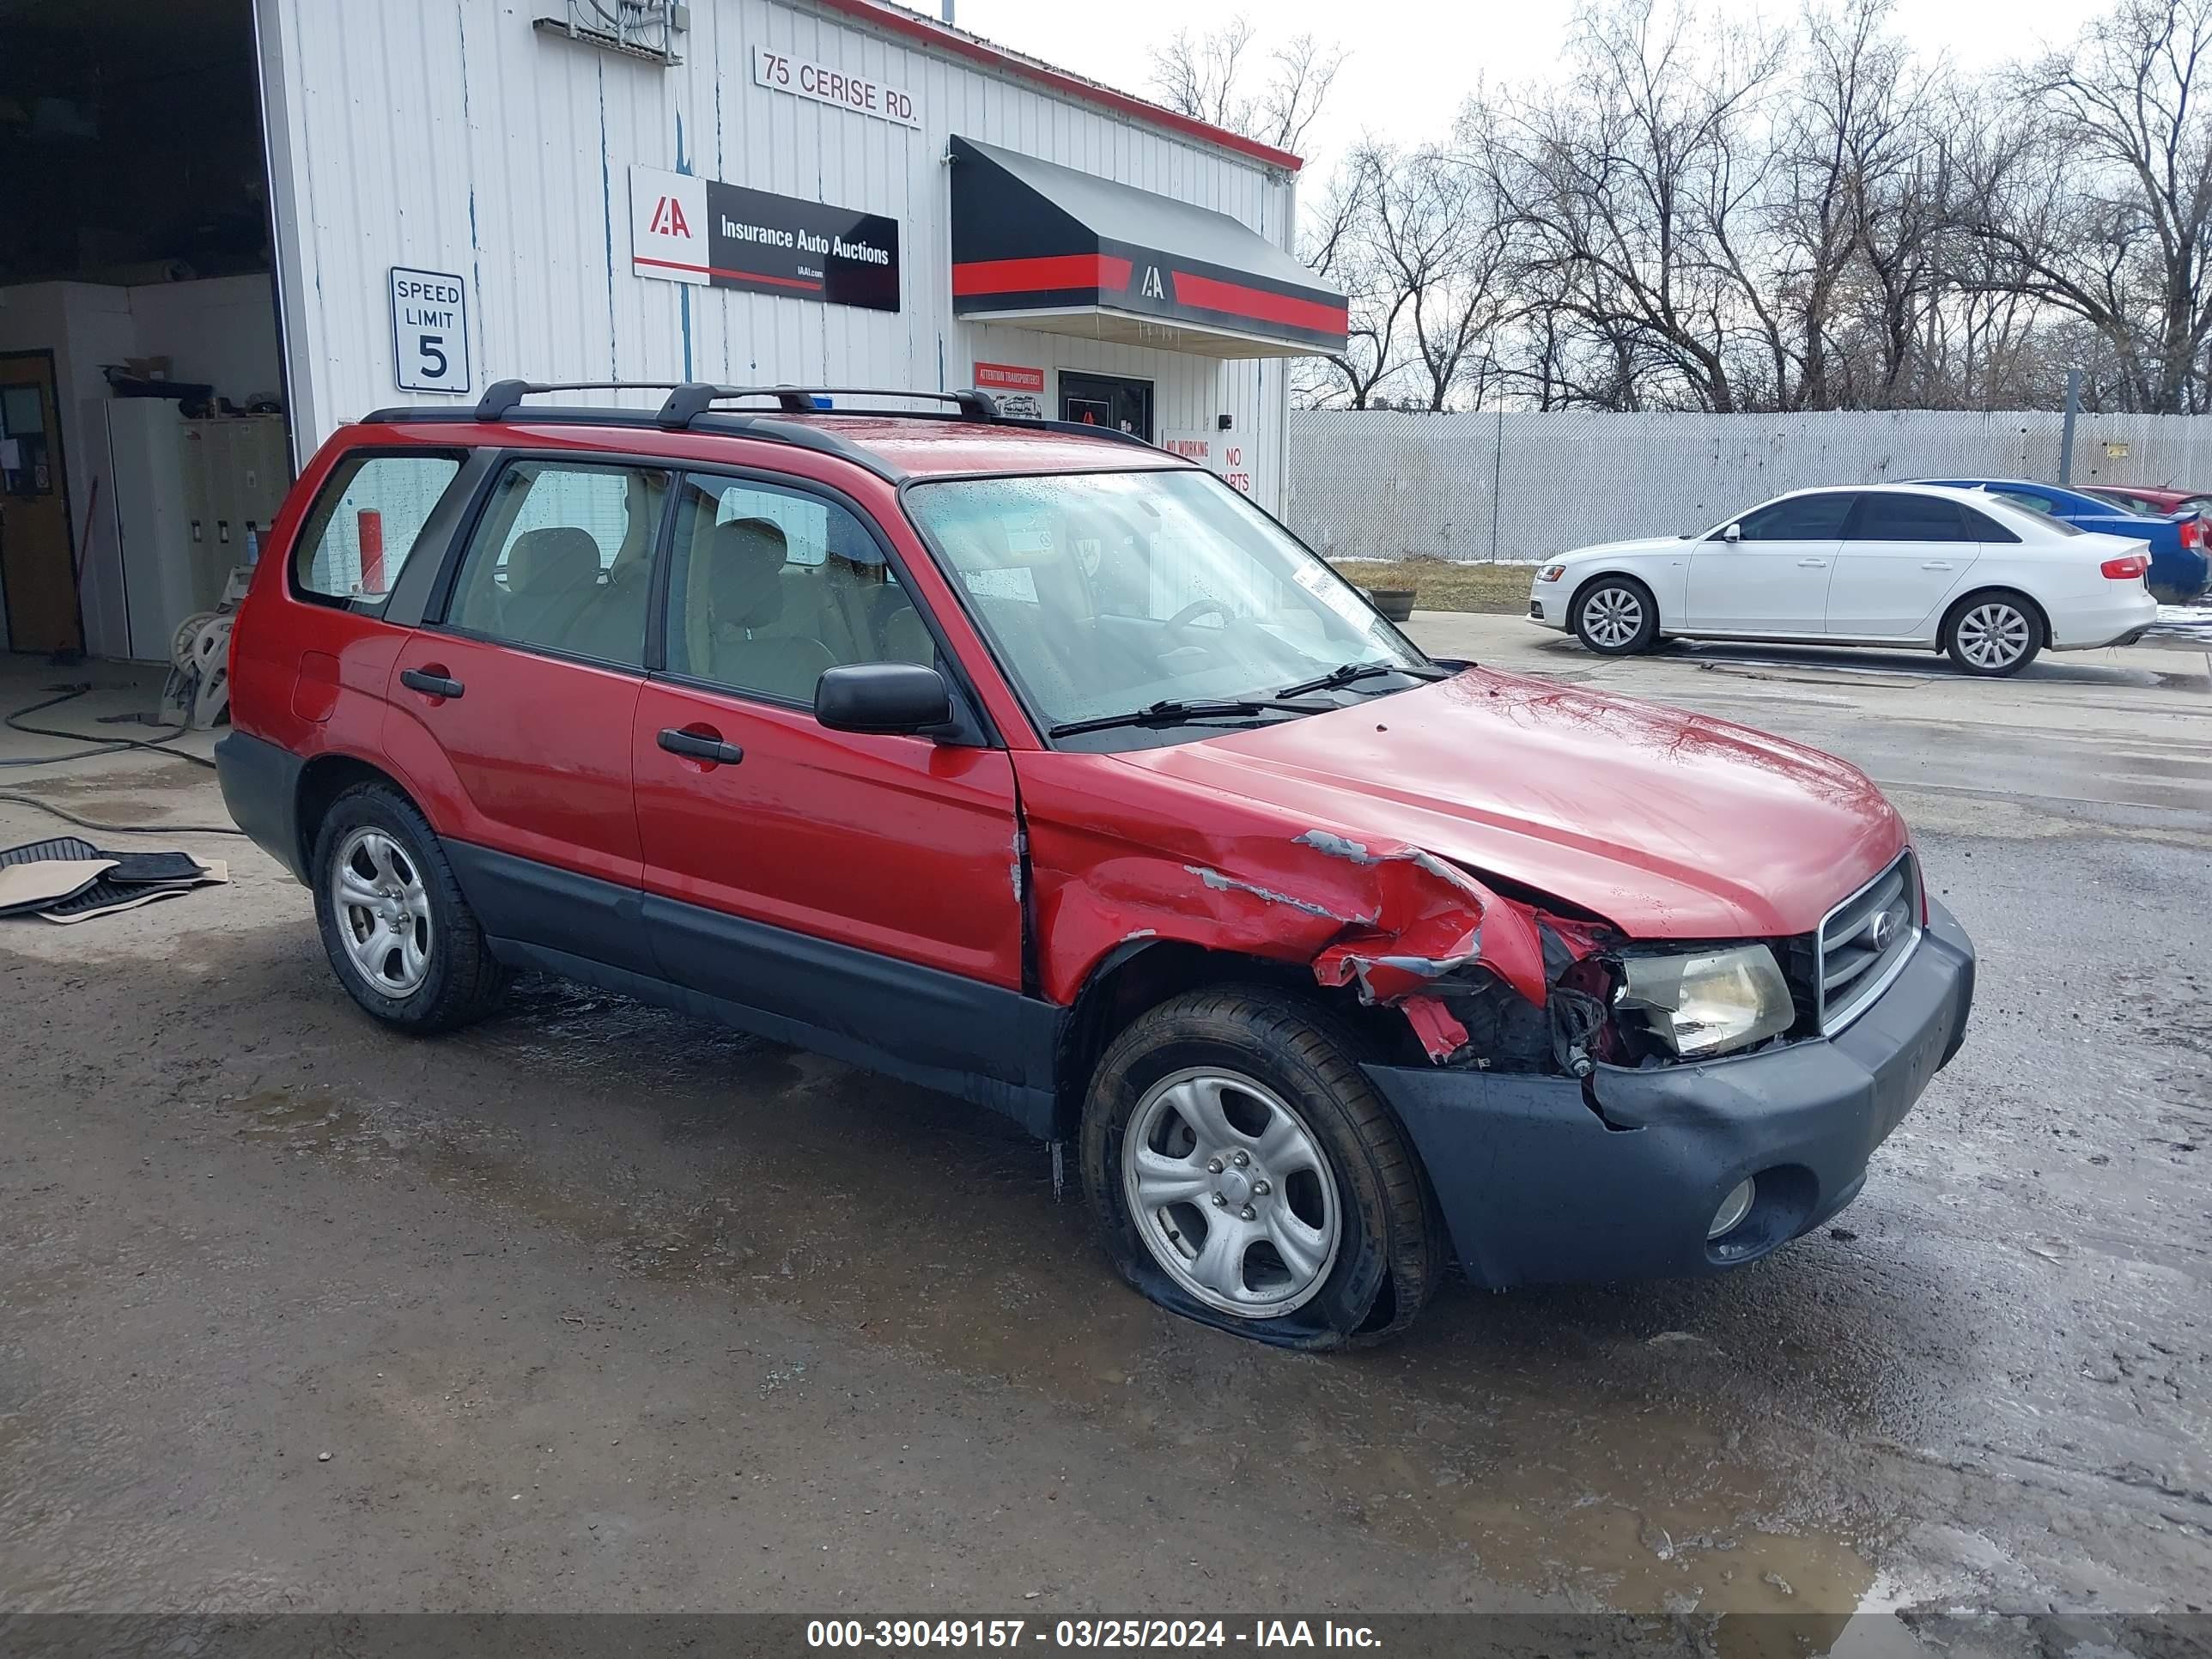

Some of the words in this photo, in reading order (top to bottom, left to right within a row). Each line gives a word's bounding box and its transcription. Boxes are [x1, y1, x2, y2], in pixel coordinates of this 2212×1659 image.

[763, 53, 790, 85] 75
[800, 65, 876, 110] CERISE
[886, 90, 917, 121] RD.
[721, 214, 793, 248] Insurance
[797, 228, 829, 254] Auto
[832, 235, 889, 265] Auctions
[797, 265, 823, 278] IAAI.com
[398, 281, 459, 303] SPEED
[406, 307, 453, 329] LIMIT
[420, 335, 447, 378] 5
[980, 368, 1004, 382] ATTENTION
[1167, 440, 1176, 453] NO
[1178, 440, 1209, 458] WORKING
[1225, 447, 1242, 466] NO
